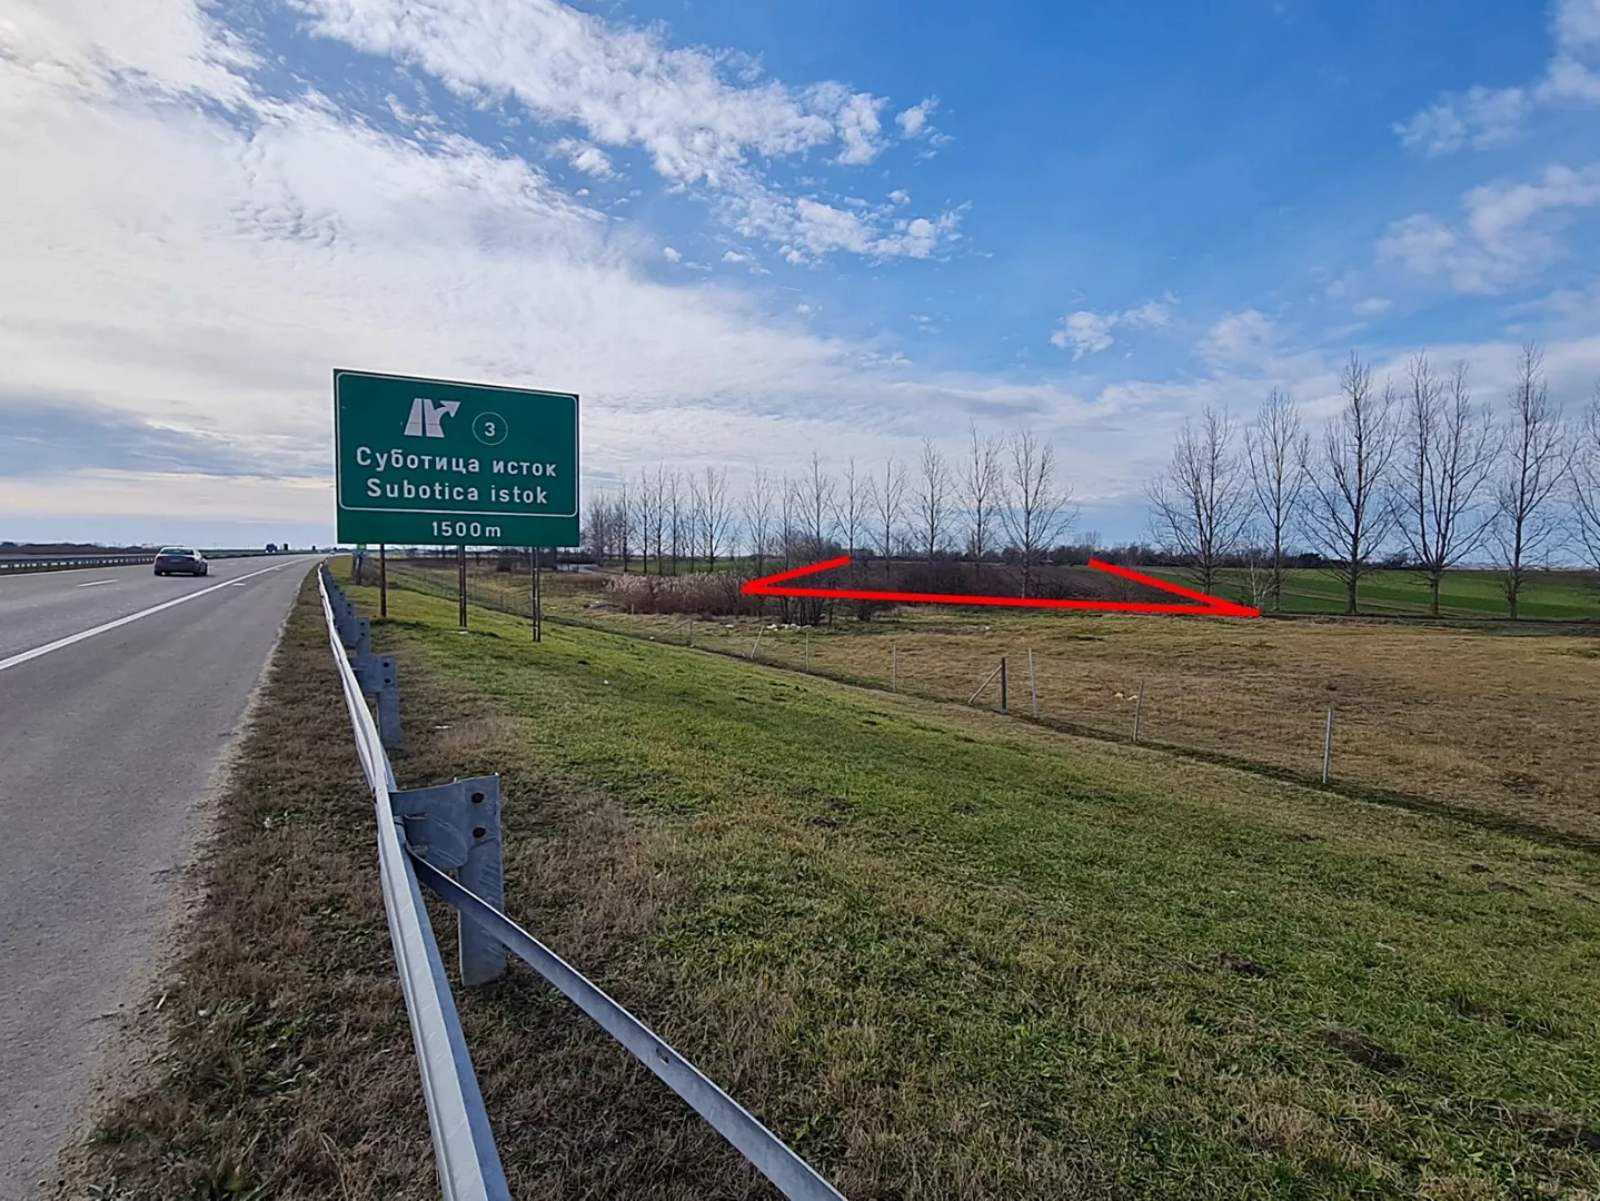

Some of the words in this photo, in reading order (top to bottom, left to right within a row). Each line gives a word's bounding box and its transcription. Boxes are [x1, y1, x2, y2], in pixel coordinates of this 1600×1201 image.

[485, 422, 496, 437] 3
[356, 446, 480, 474] Суботица
[493, 460, 557, 477] исток
[367, 478, 479, 501] Subotica
[491, 485, 548, 504] istok
